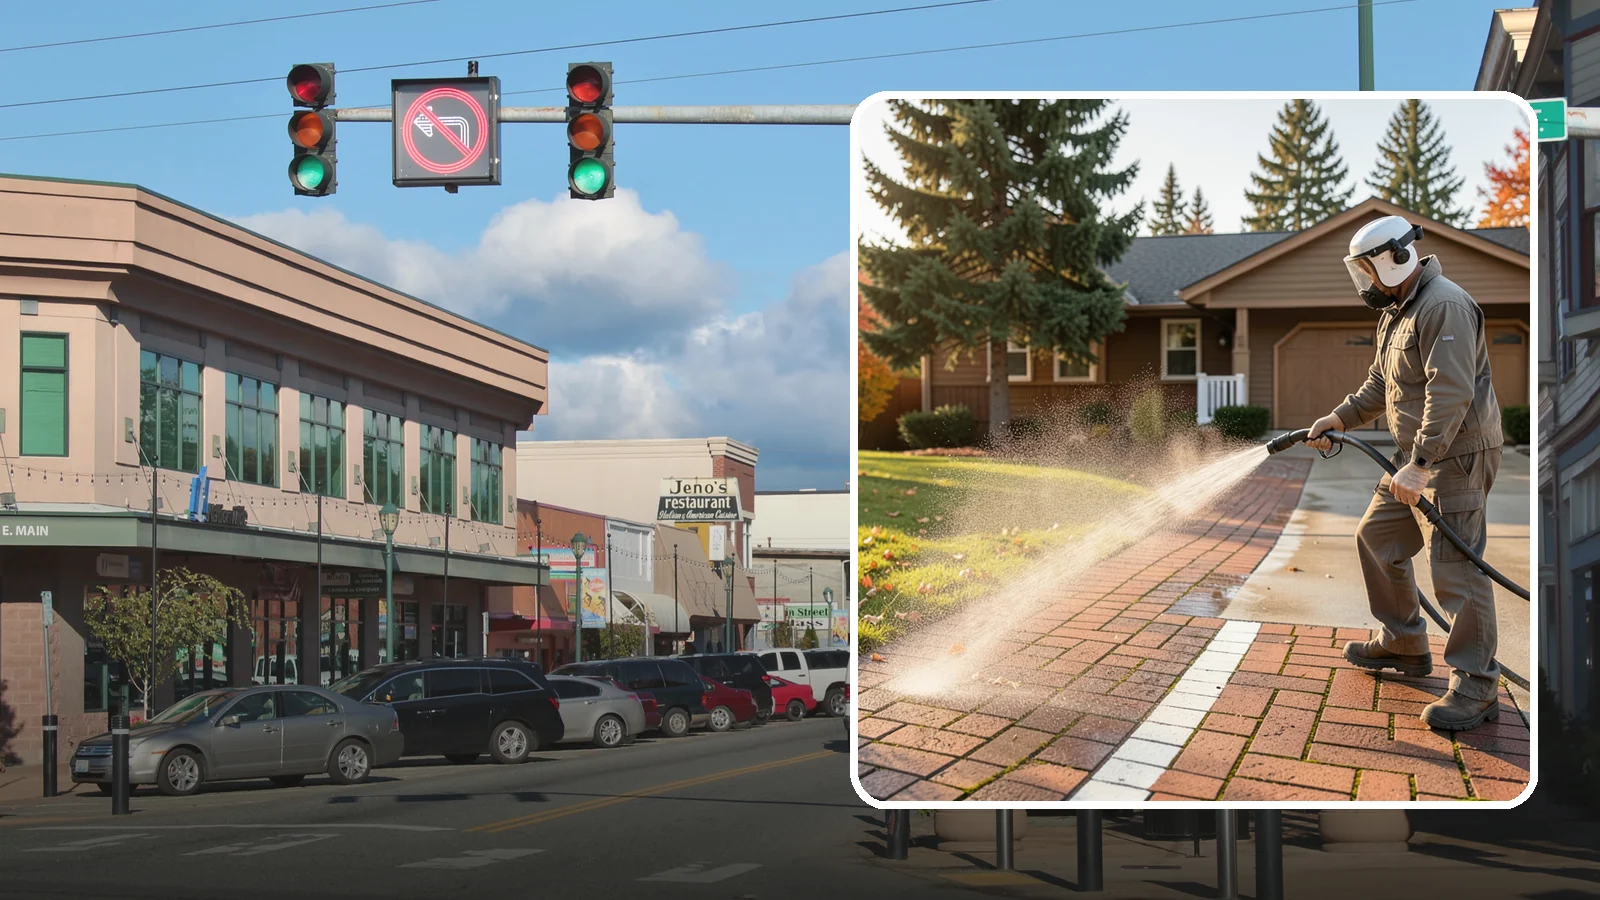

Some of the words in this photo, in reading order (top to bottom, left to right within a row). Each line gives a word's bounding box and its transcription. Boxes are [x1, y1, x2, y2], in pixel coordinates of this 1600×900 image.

[670, 480, 727, 494] Jeno's
[665, 497, 731, 509] restaurant
[659, 510, 681, 519] Italian
[686, 510, 714, 519] American
[715, 509, 737, 519] Cuisine
[2, 525, 13, 536] E.
[15, 525, 49, 536] MAIN
[797, 607, 828, 616] Street
